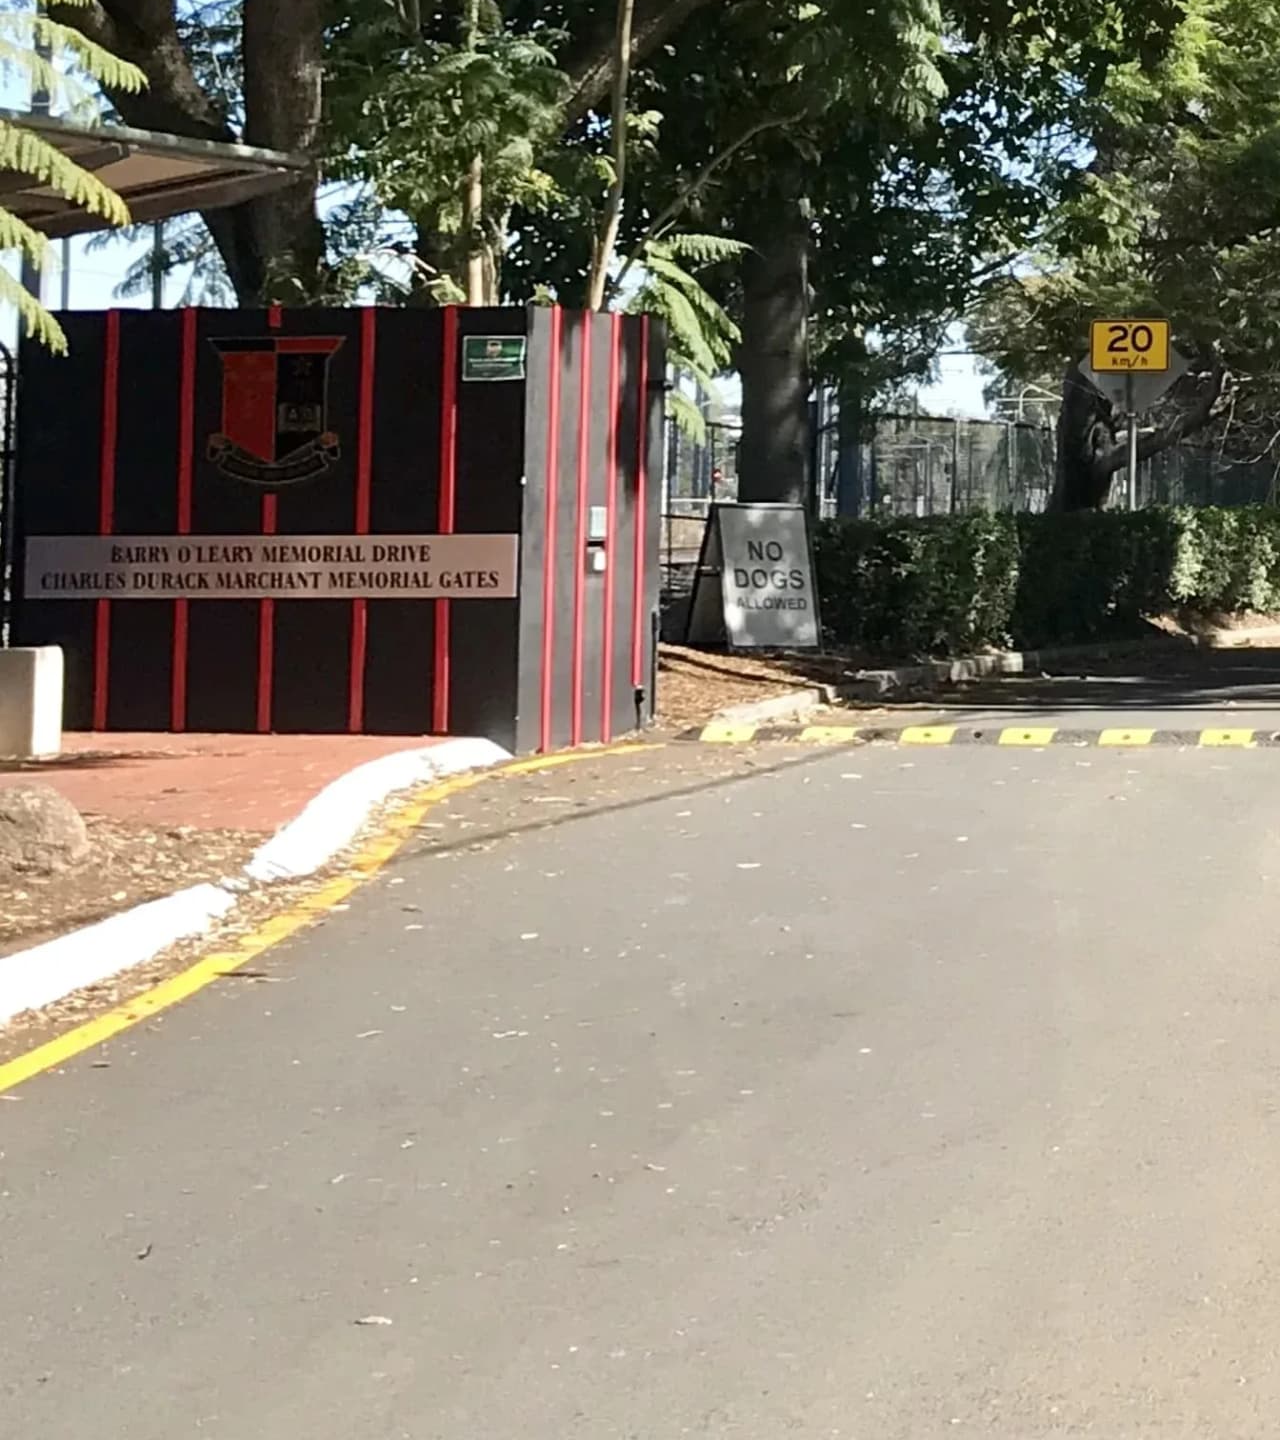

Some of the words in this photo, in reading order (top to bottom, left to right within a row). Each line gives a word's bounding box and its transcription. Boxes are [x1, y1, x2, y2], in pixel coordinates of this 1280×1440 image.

[1107, 325, 1153, 352] 20
[111, 545, 170, 564] BARRY
[261, 545, 366, 563] MEMORIAL
[372, 545, 431, 562] DRIVE
[747, 541, 783, 561] NO
[41, 572, 126, 590] CHARLES
[133, 572, 209, 590] DURACK
[215, 571, 322, 590] MARCHANT
[329, 571, 433, 589] MEMORIAL
[438, 571, 499, 588] GATES
[734, 568, 805, 590] DOGS
[737, 596, 808, 610] ALLOWED
